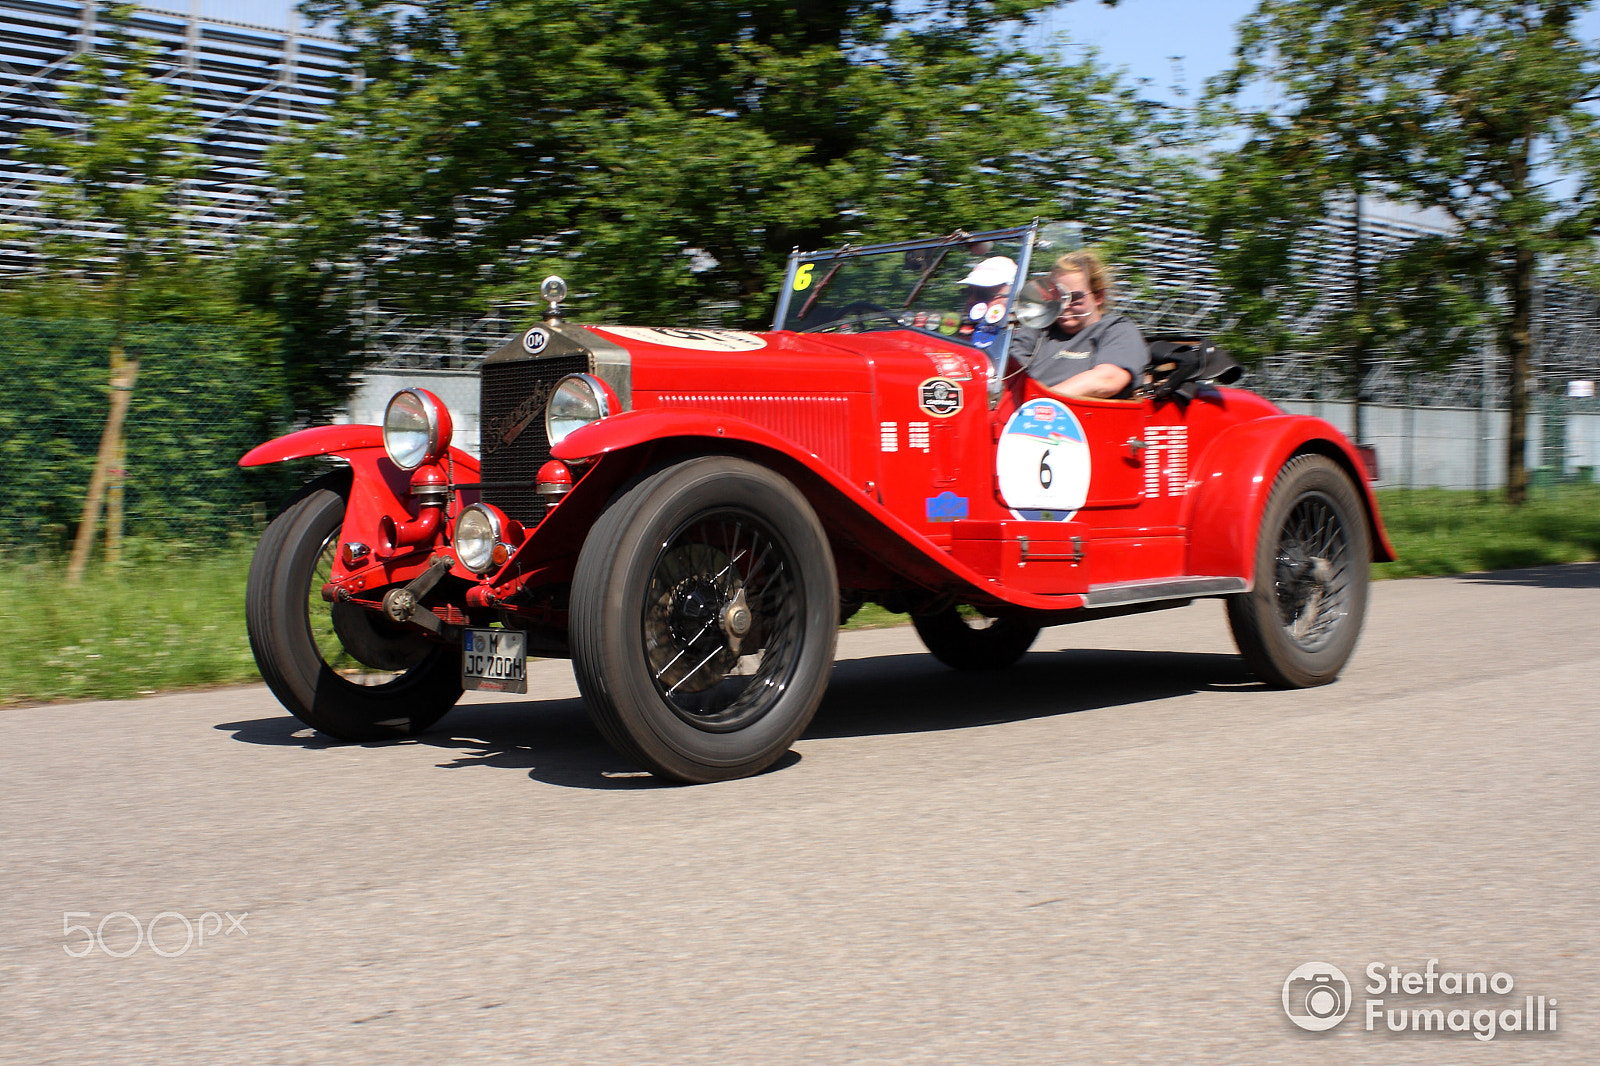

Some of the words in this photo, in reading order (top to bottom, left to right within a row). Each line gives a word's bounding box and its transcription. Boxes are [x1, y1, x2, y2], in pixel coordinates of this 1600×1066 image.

[793, 263, 815, 291] 6
[528, 334, 543, 347] OM
[1039, 449, 1053, 490] 6
[489, 634, 498, 654] M
[466, 655, 484, 675] JC
